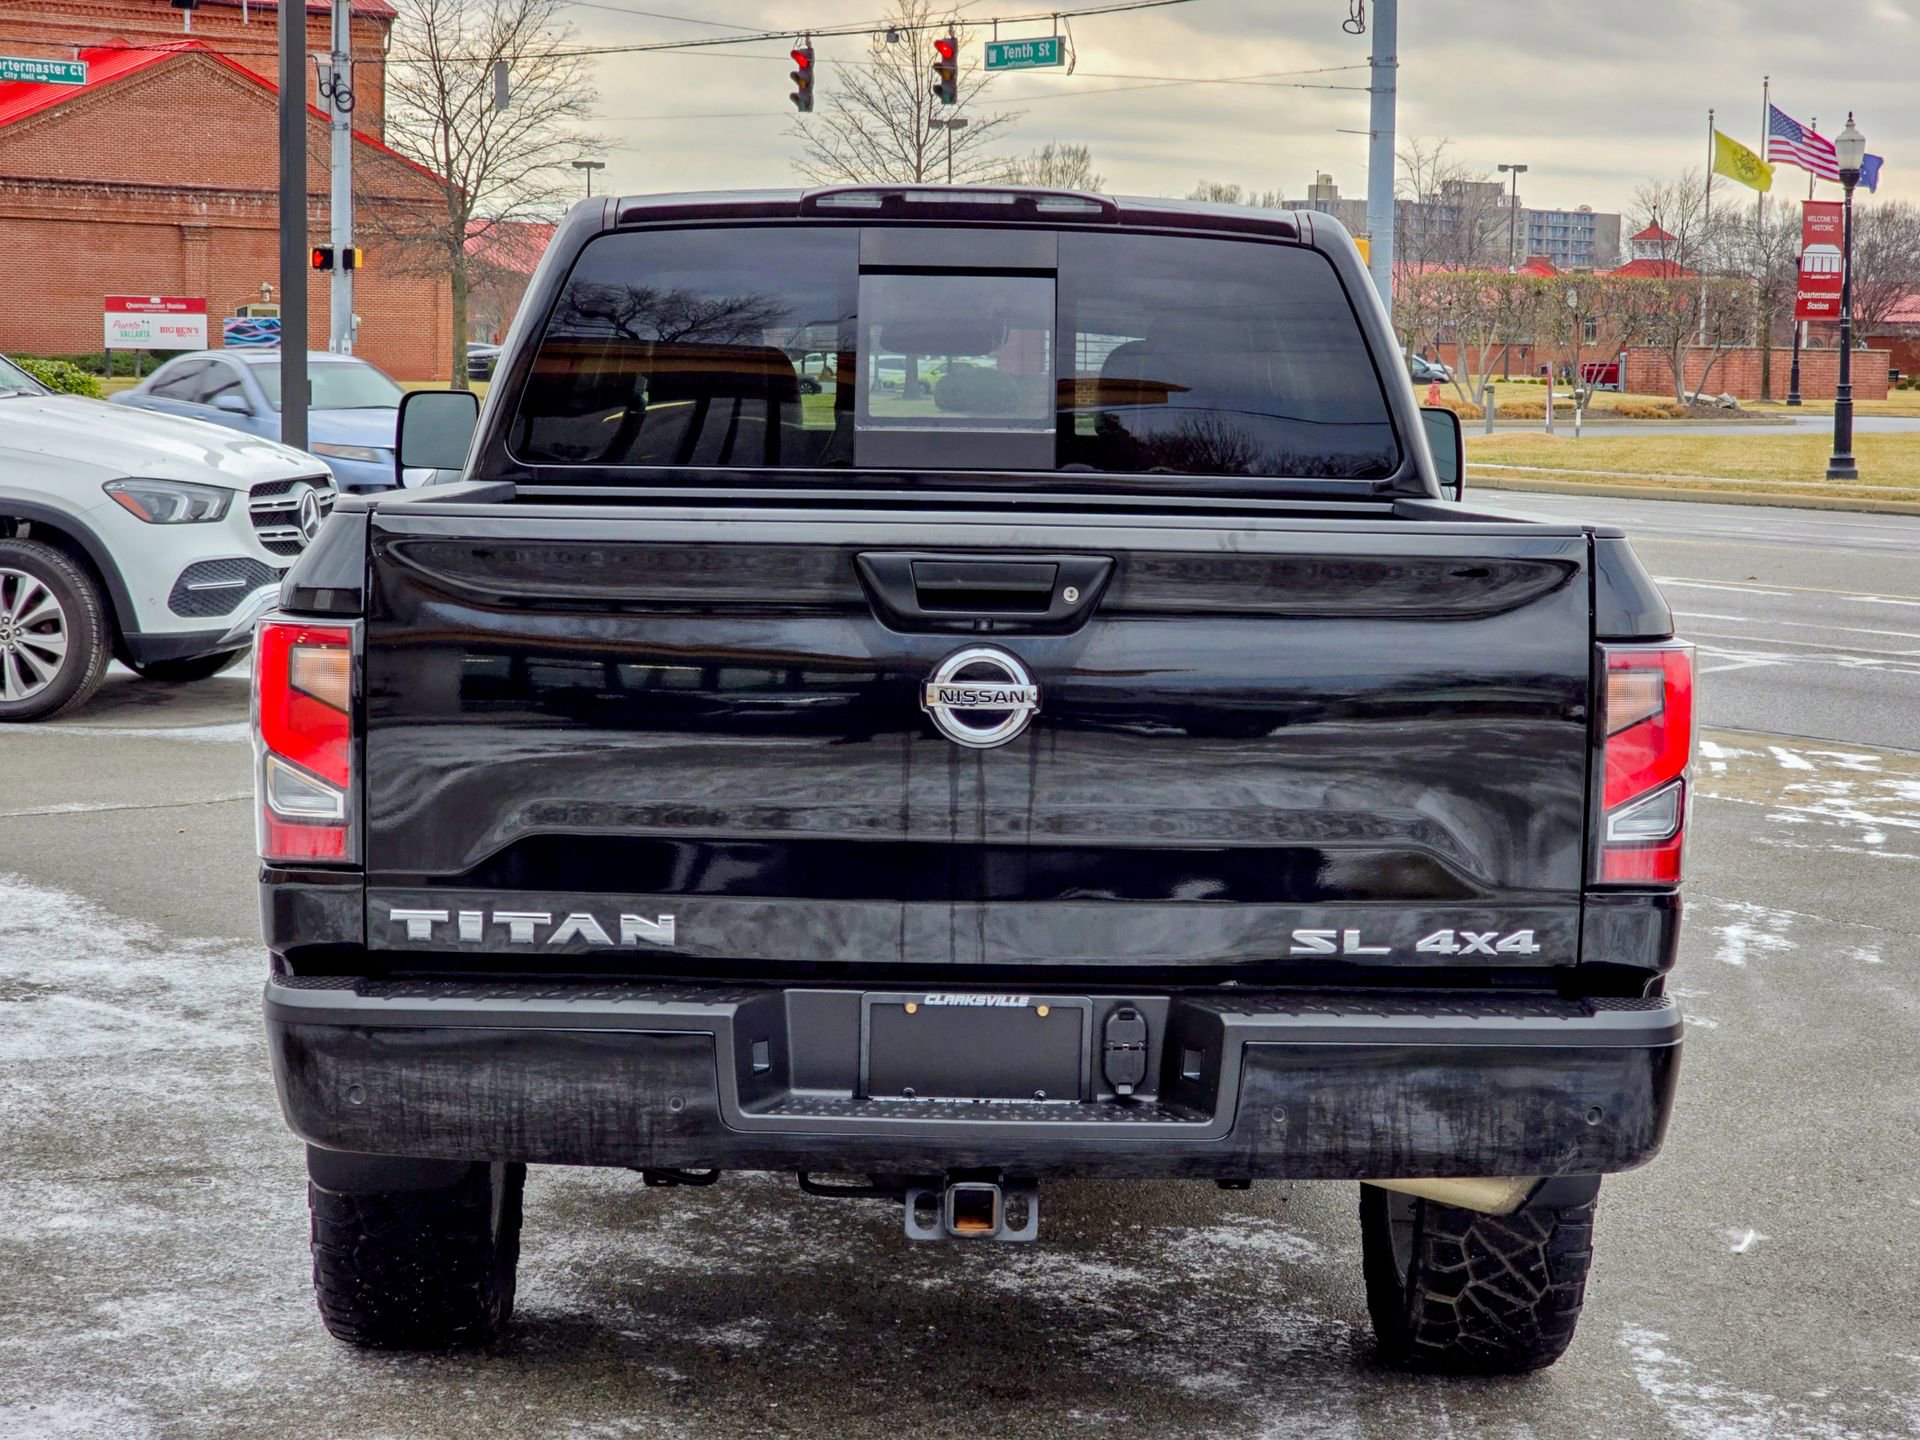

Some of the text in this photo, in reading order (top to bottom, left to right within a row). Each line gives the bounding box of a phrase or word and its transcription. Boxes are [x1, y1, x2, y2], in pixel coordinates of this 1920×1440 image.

[1003, 42, 1050, 59] Tenth St
[0, 60, 83, 76] rtermaster Ct
[3, 71, 35, 80] City Hall
[1807, 215, 1831, 223] WELCOME
[1798, 290, 1841, 300] Quartermaster
[1807, 301, 1829, 310] Station
[113, 320, 141, 329] Puerto
[120, 330, 150, 338] VALLARTA
[940, 690, 1024, 703] NISSAN
[390, 909, 675, 946] TITAN
[1290, 929, 1391, 955] SL
[924, 994, 1029, 1007] CLARKSVILLE
